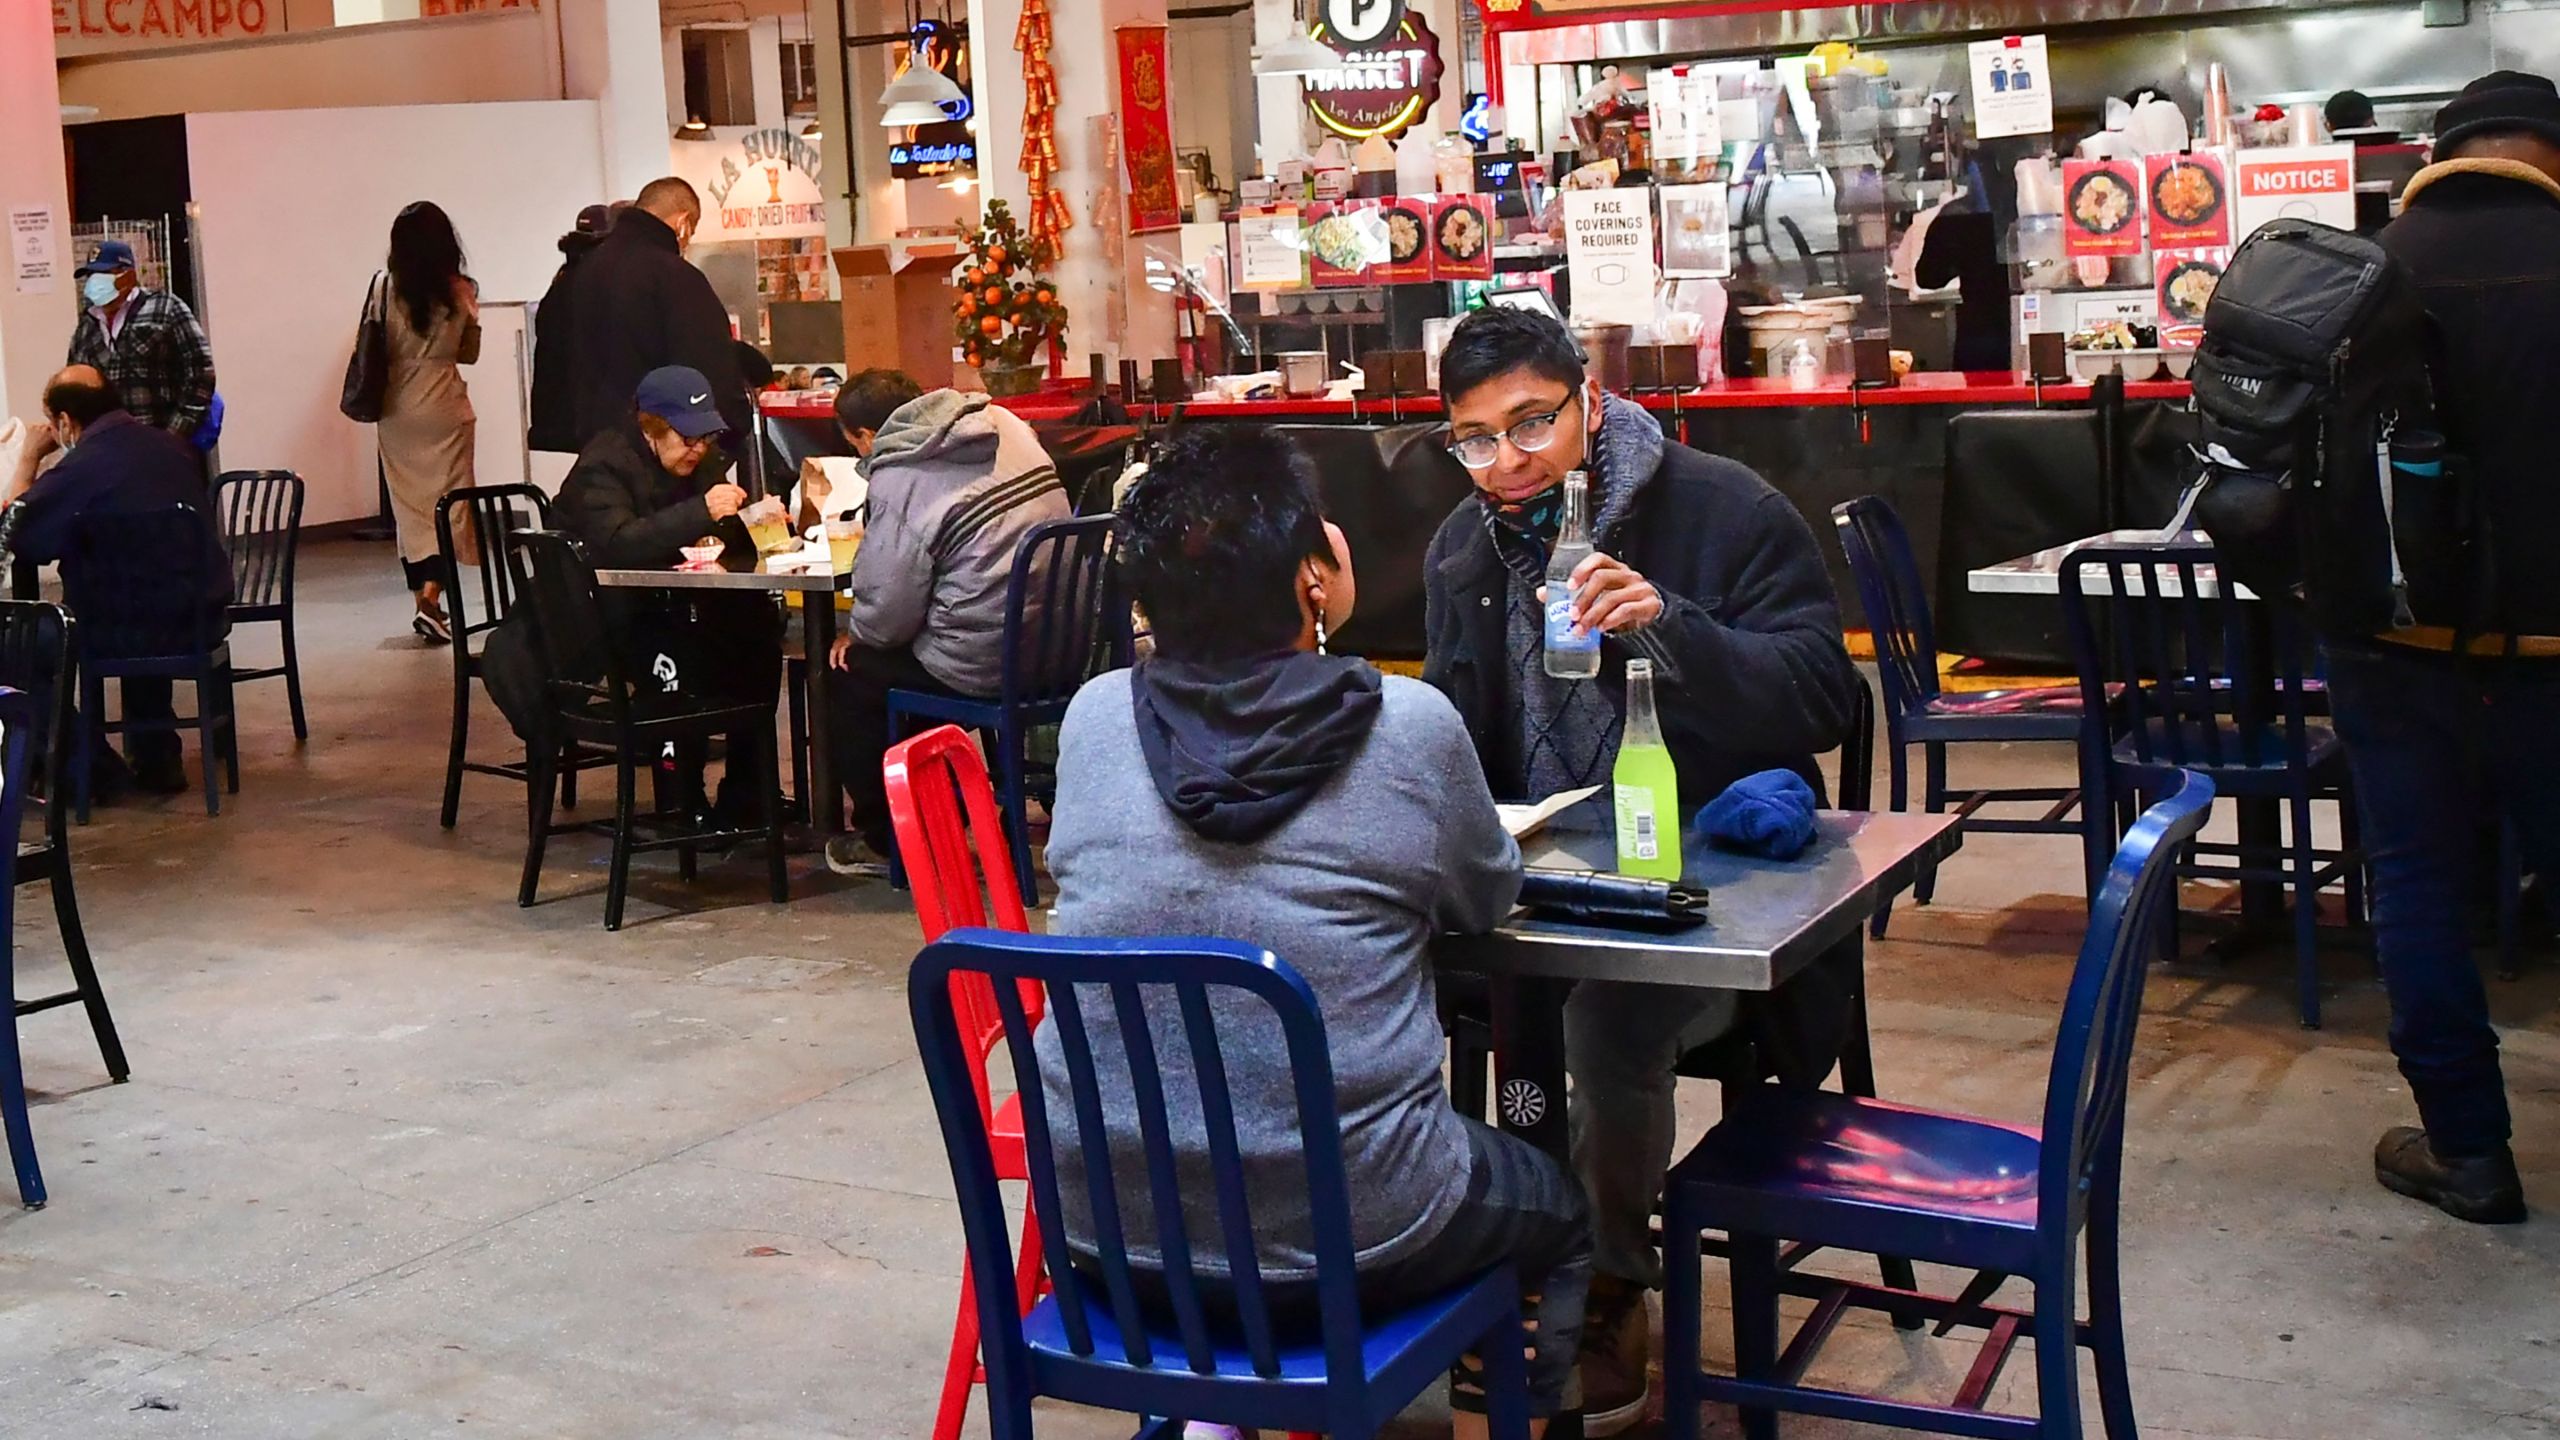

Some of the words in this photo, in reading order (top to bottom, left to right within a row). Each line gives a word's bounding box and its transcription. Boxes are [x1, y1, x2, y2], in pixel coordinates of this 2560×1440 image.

[1304, 50, 1427, 92] MARKET
[1329, 100, 1349, 119] Los
[708, 156, 741, 209] LA
[742, 131, 824, 200] HUERT
[2253, 169, 2337, 191] NOTICE
[1594, 201, 1622, 214] FACE
[1575, 217, 1643, 232] COVERINGS
[1581, 234, 1639, 248] REQUIRED
[2117, 305, 2142, 313] WE
